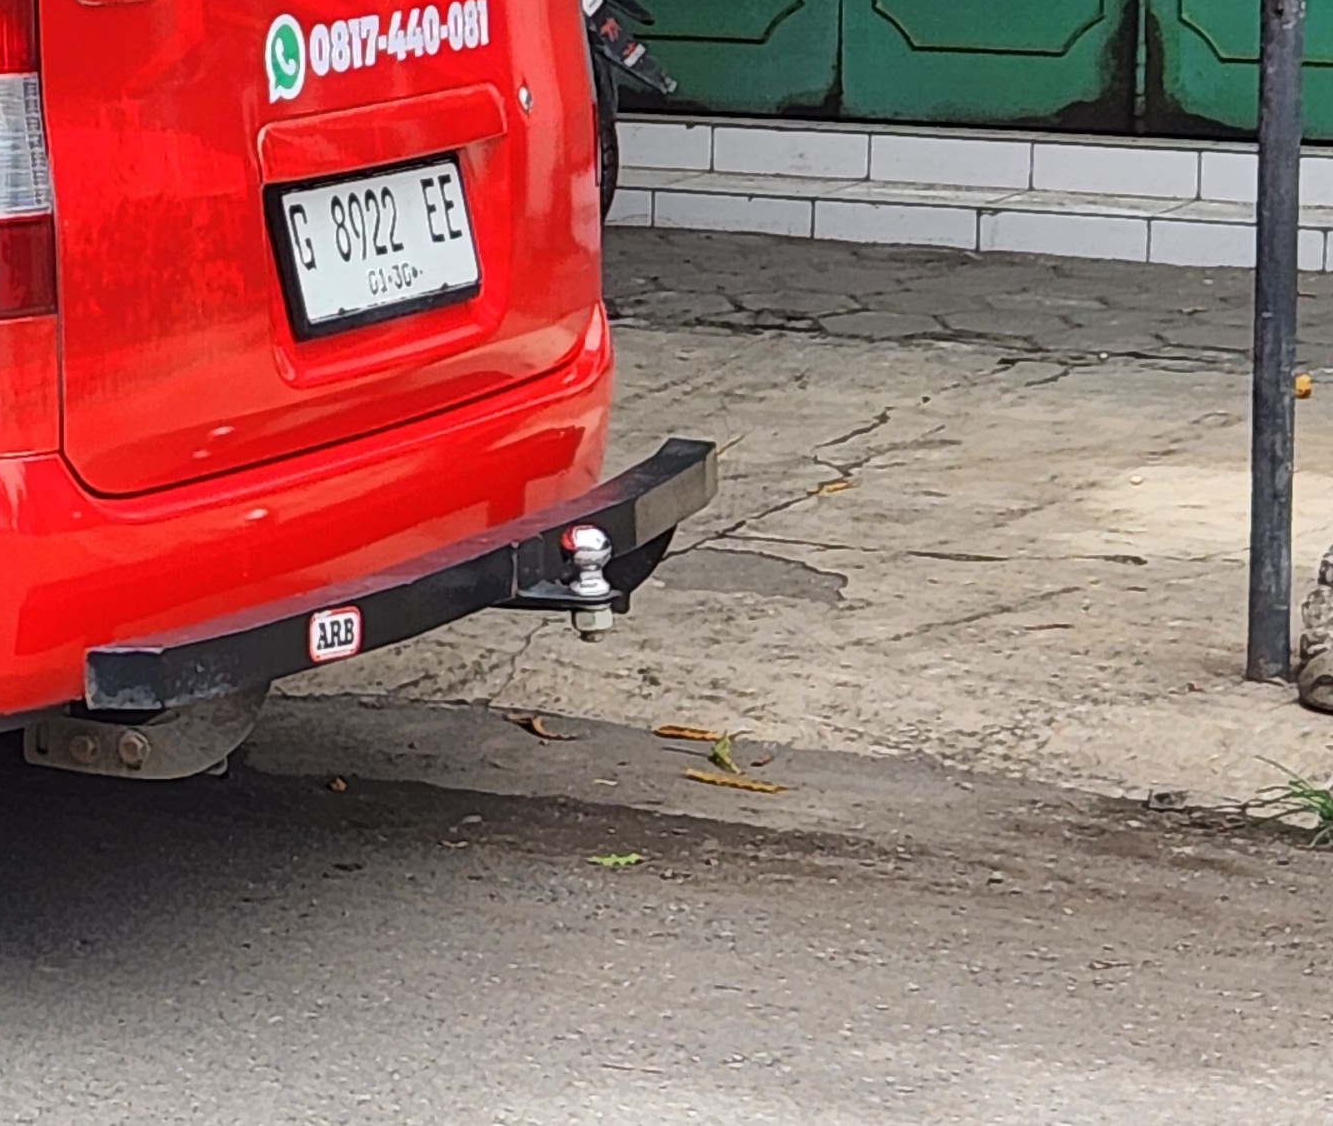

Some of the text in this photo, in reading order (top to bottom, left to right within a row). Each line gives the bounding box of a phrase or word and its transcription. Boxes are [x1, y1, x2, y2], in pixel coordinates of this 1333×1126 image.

[288, 173, 464, 272] G 8922 EE
[316, 617, 355, 651] ARB
